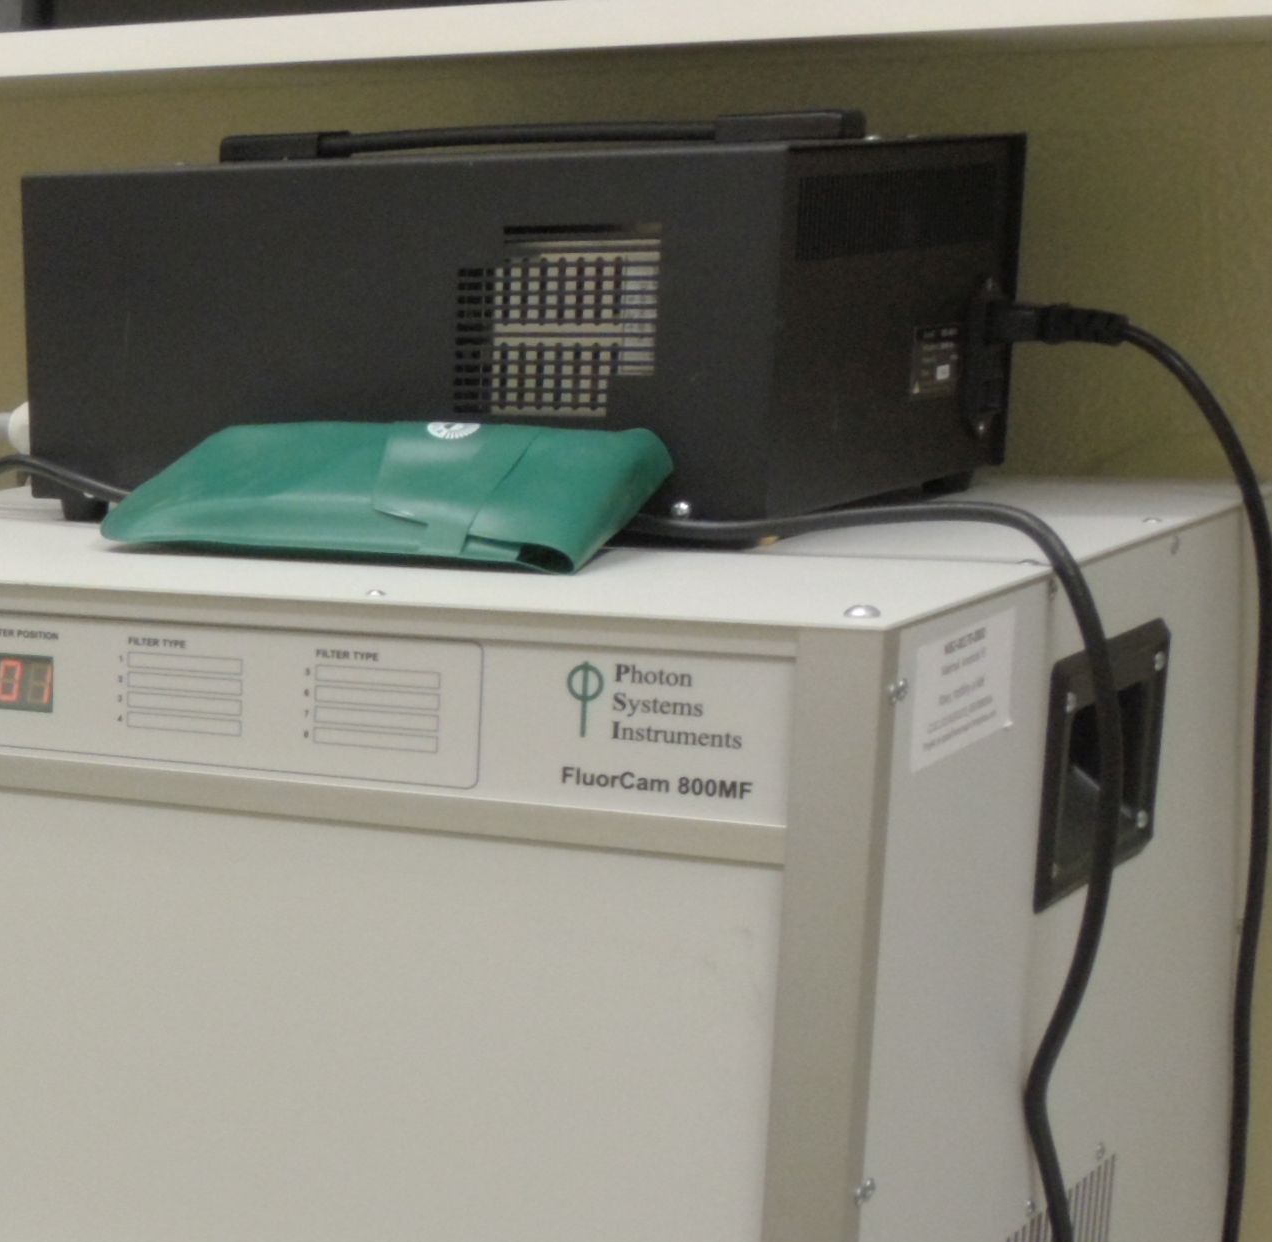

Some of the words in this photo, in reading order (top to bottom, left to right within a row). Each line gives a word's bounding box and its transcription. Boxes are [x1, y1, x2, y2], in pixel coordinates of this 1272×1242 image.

[17, 629, 59, 641] POSITION
[128, 636, 159, 647] FILTER
[162, 638, 187, 649] TYPE
[316, 649, 350, 660] FILTER
[354, 651, 379, 662] TYPE
[614, 663, 694, 688] Photon
[612, 692, 704, 718] Systems
[611, 721, 743, 750] Instruments
[561, 766, 670, 794] FluorCam
[678, 776, 754, 800] 800MF
